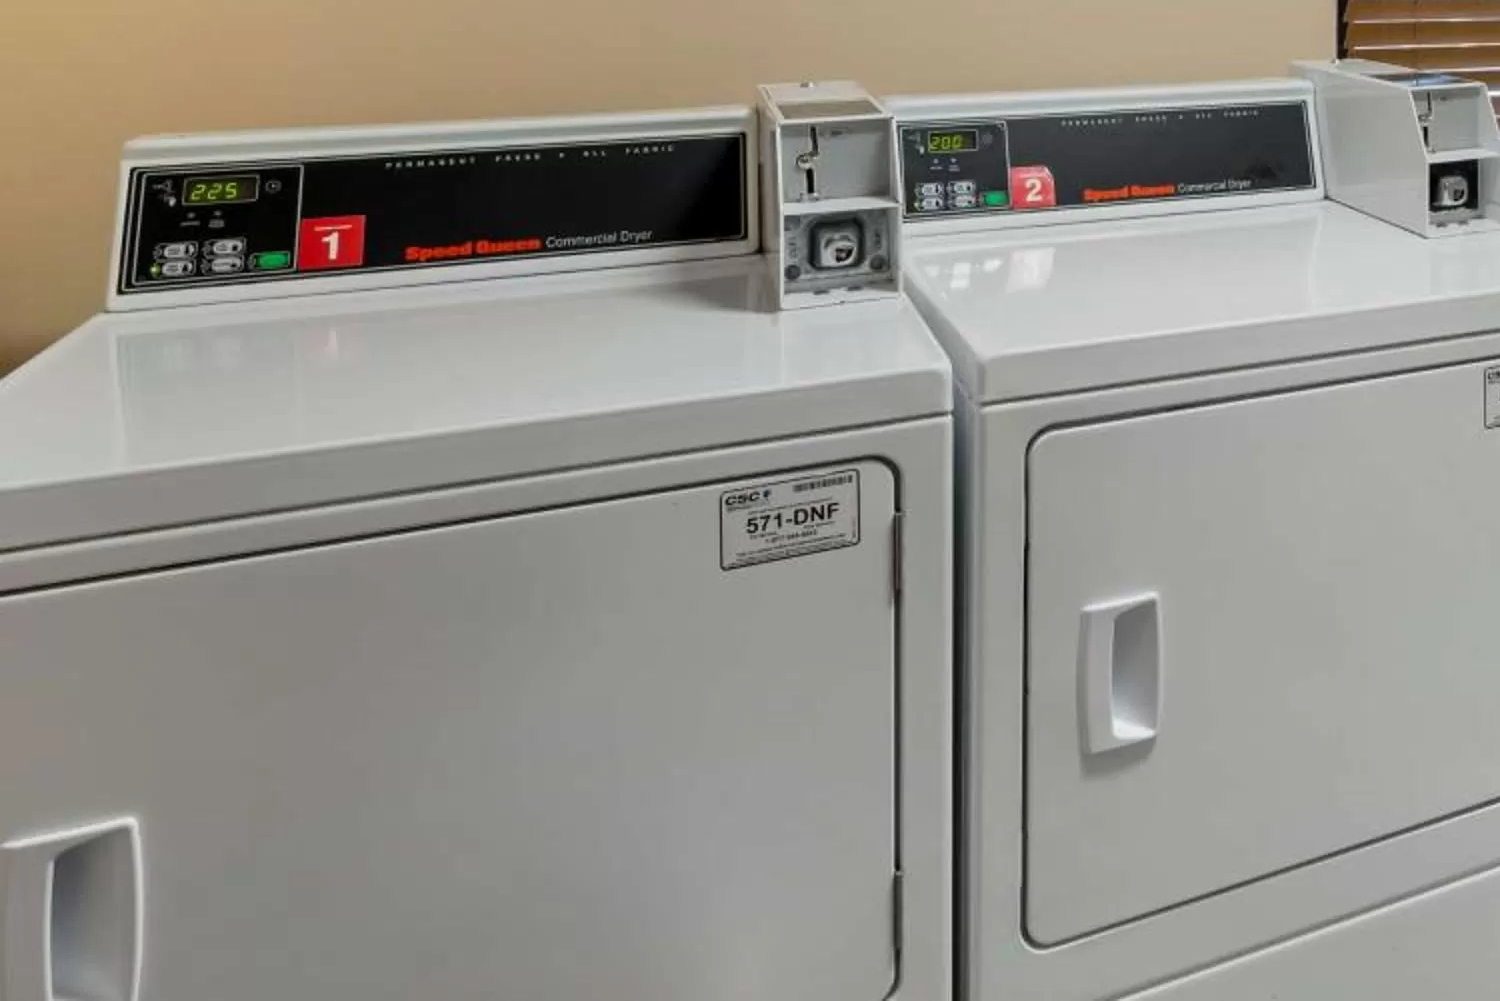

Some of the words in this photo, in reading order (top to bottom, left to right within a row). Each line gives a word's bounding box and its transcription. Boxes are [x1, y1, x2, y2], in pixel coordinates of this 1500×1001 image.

[929, 135, 964, 151] 200
[190, 181, 238, 200] 225
[1025, 178, 1043, 202] 2
[1083, 186, 1130, 202] Speed
[1130, 183, 1176, 199] Queen
[1177, 181, 1227, 193] Commercial
[1228, 178, 1252, 191] Dryer
[320, 230, 340, 261] 1
[404, 240, 473, 262] Speed
[476, 237, 542, 256] Queen
[545, 233, 617, 249] Commercial
[620, 230, 653, 244] Dryer
[725, 490, 761, 506] CSC
[745, 502, 839, 534] 571-DNF
